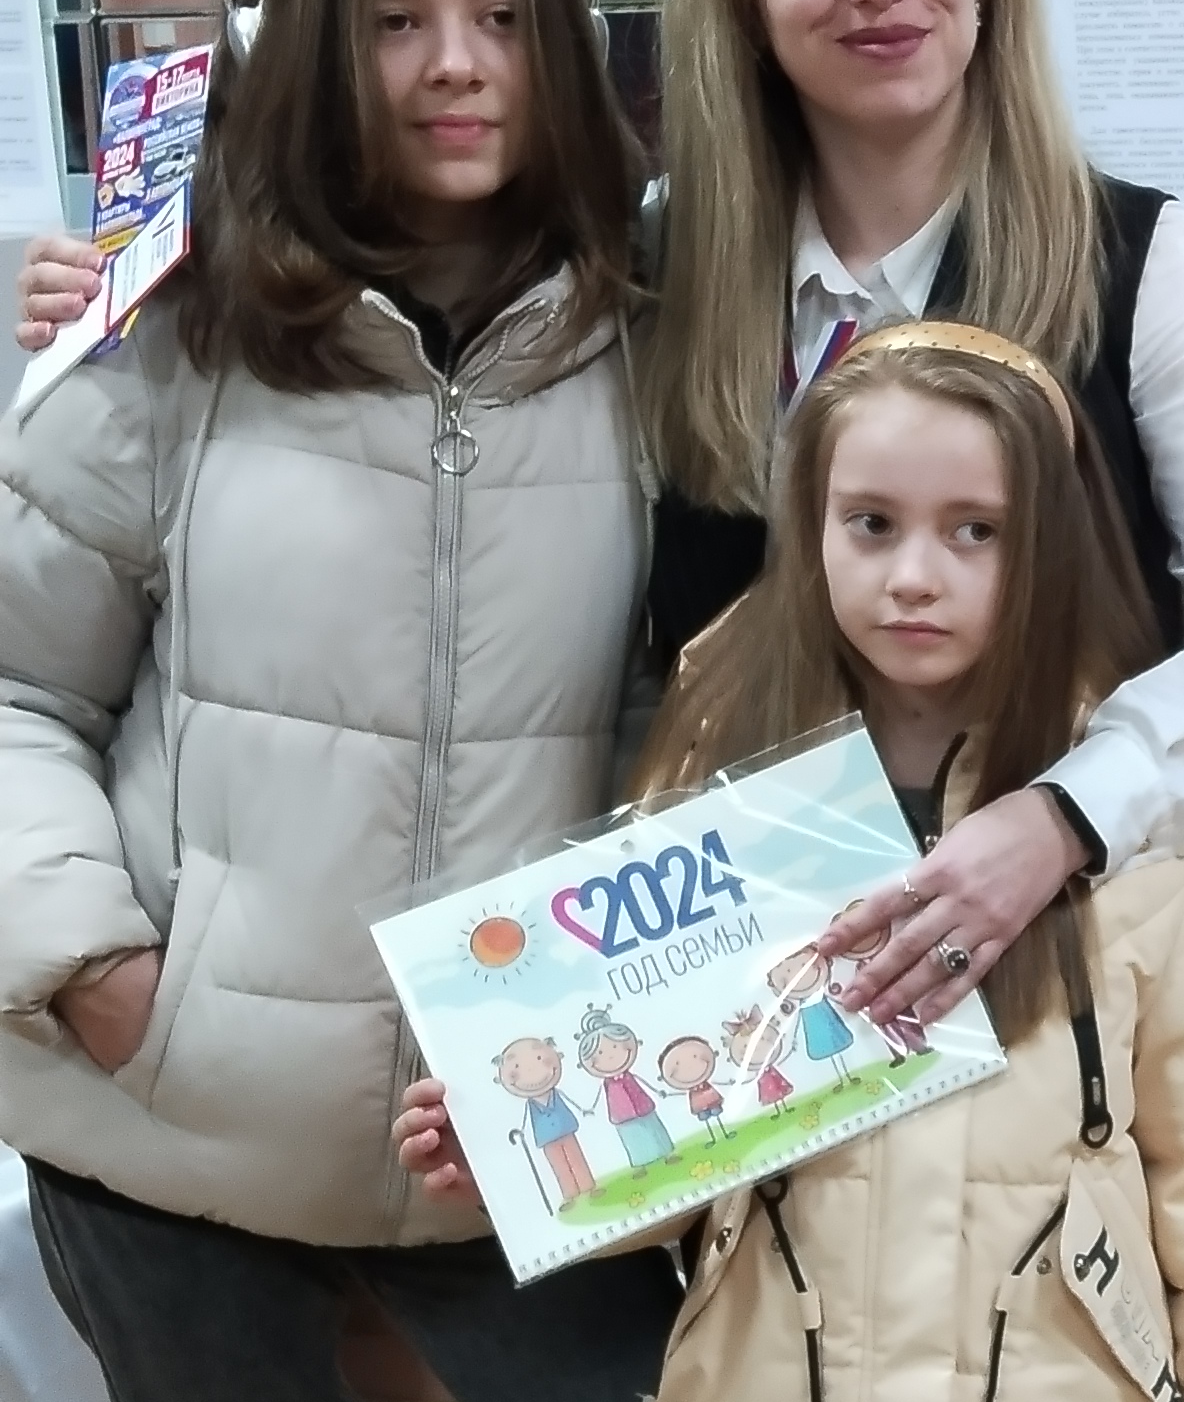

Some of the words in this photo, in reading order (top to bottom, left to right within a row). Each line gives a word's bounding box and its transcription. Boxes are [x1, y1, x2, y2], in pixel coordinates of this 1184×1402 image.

[103, 140, 136, 172] 2024
[578, 828, 748, 959] 2024
[606, 953, 670, 1001] ГОД
